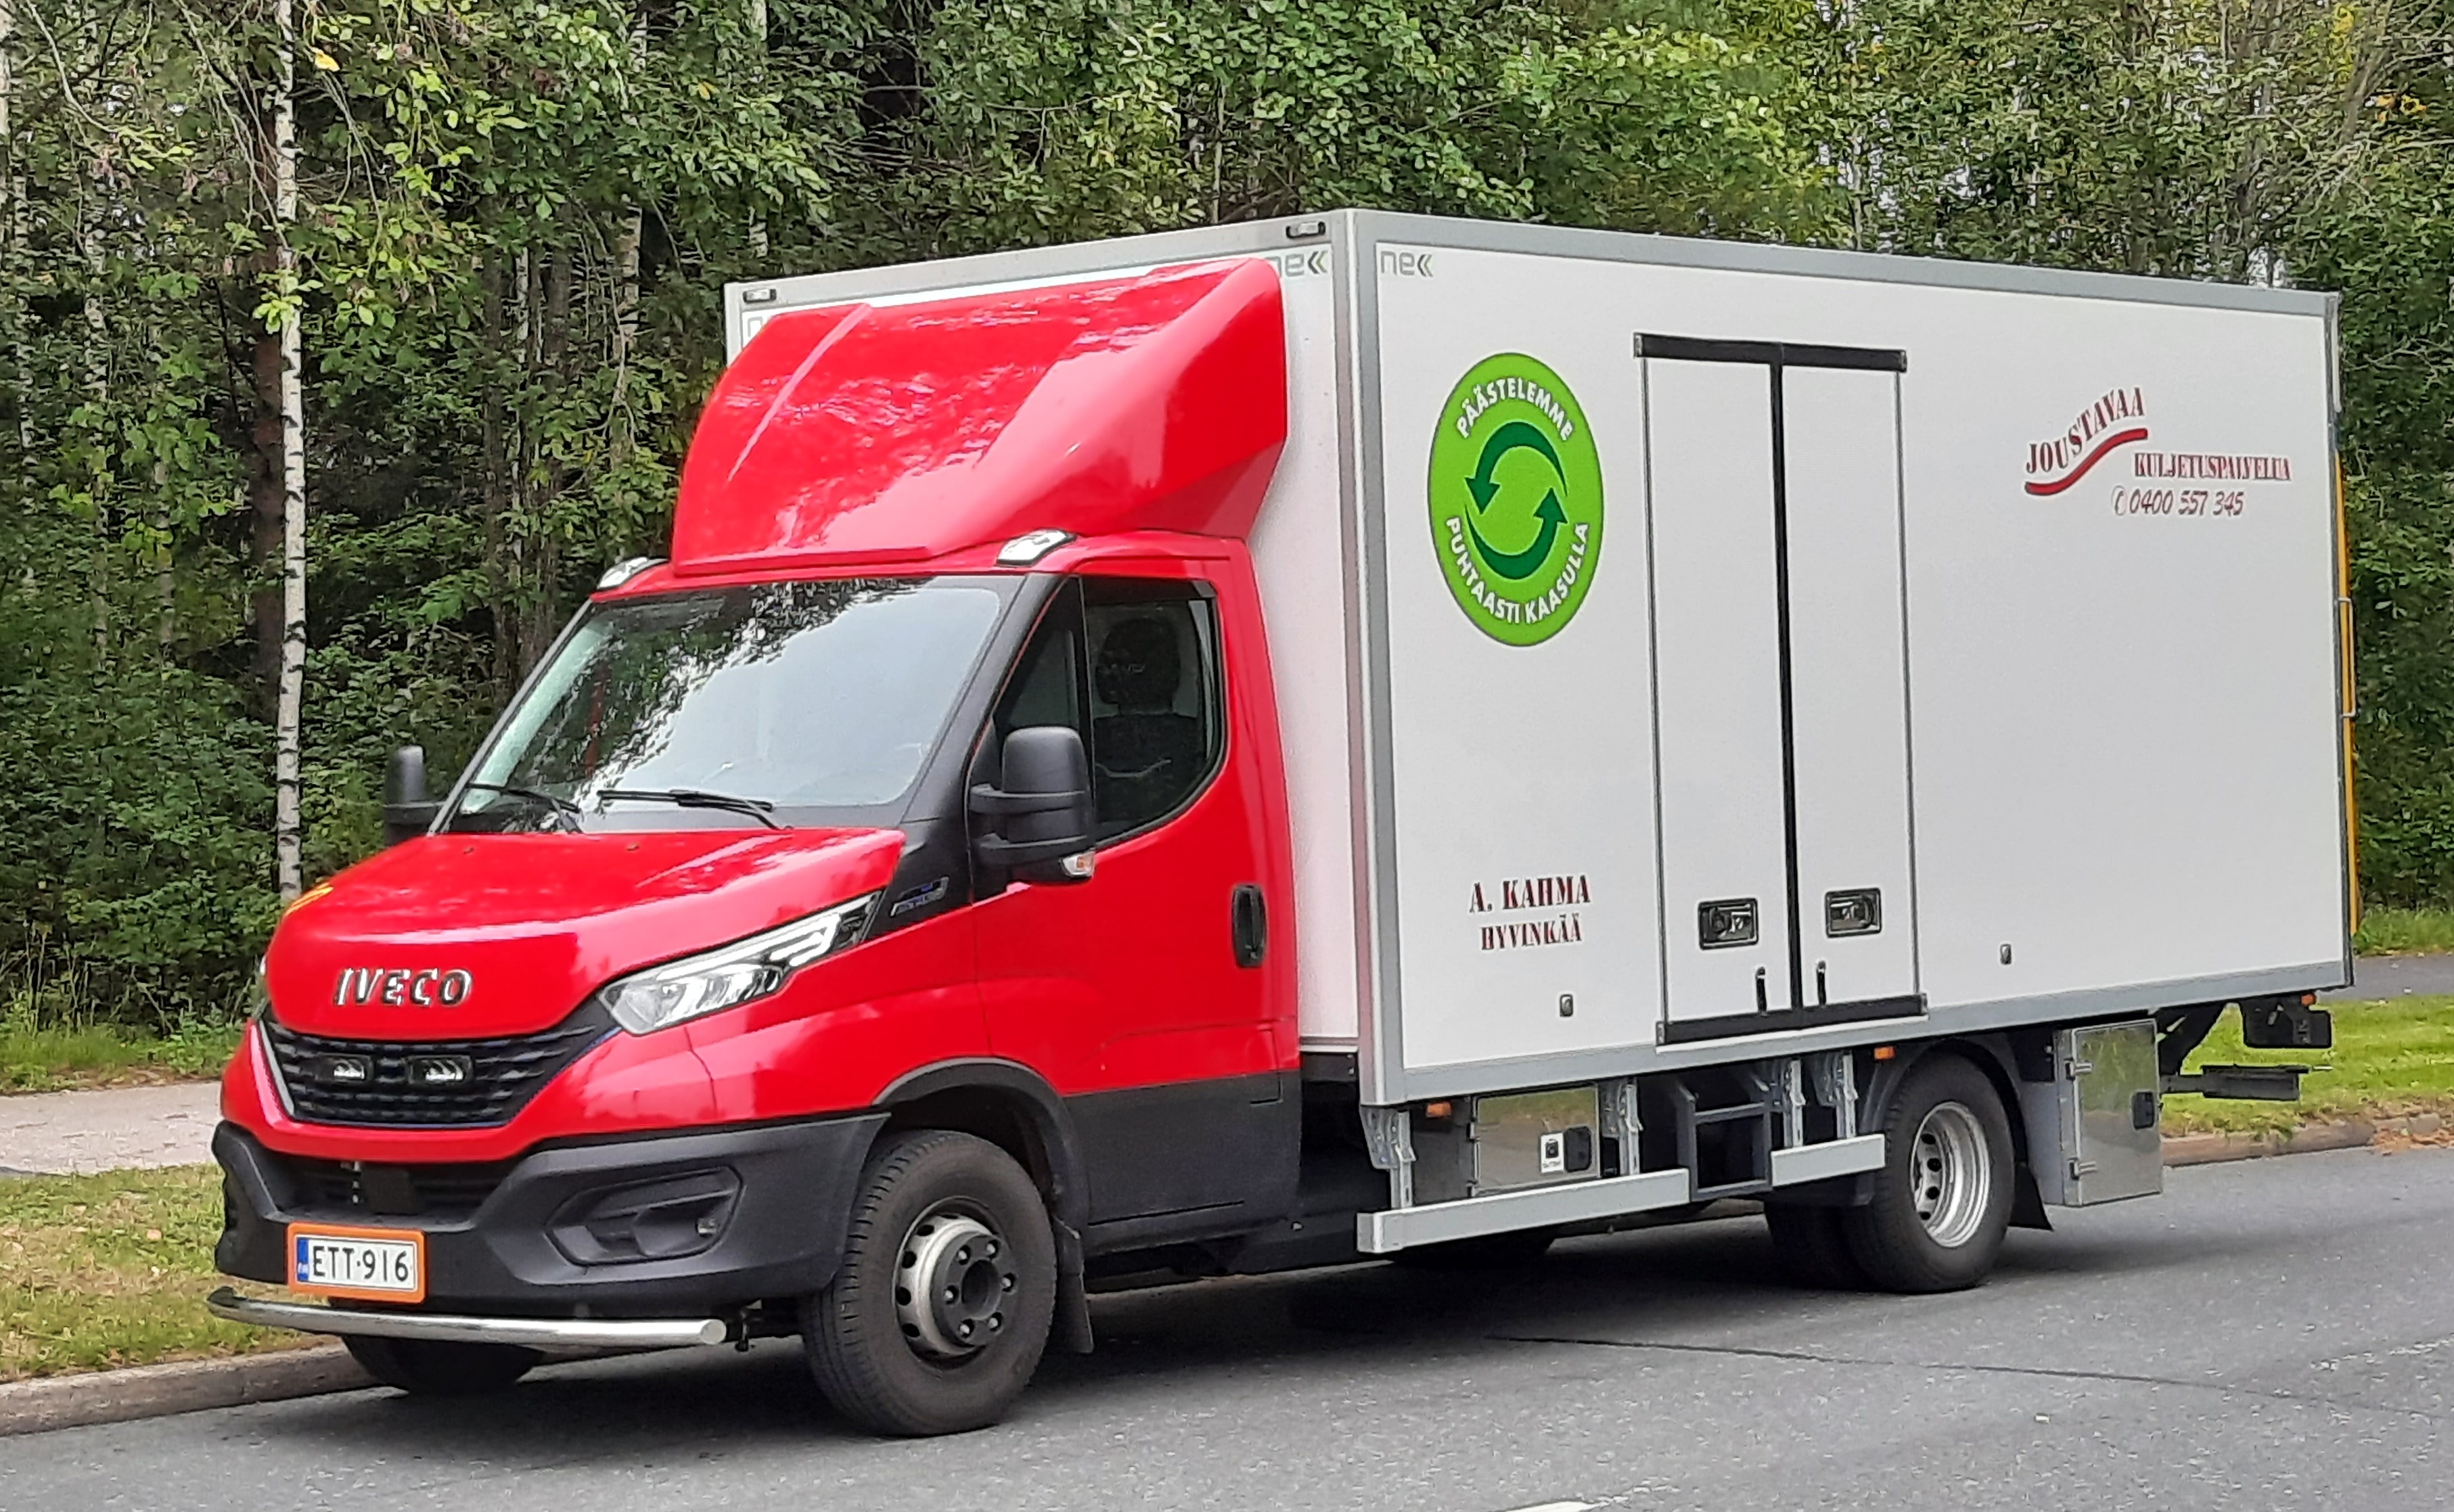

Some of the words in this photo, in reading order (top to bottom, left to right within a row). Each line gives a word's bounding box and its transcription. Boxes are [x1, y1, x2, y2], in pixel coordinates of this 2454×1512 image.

[1457, 377, 1574, 440] PÄÄSTELEMME
[2026, 387, 2144, 474] JOUSTAVAA
[2135, 453, 2292, 480] KULJETUSPALVELUA
[2129, 488, 2174, 515] 0400
[2178, 490, 2209, 516] 557
[2213, 490, 2244, 516] 345
[1447, 517, 1520, 624] PUHTAASTI
[1525, 524, 1589, 624] KAASULLA
[1469, 882, 1493, 913] A.
[1502, 875, 1591, 910] KAHMA
[1480, 913, 1583, 950] HYVINKÄÄ
[334, 967, 473, 1006] IVECO
[313, 1245, 409, 1282] ETT-916
